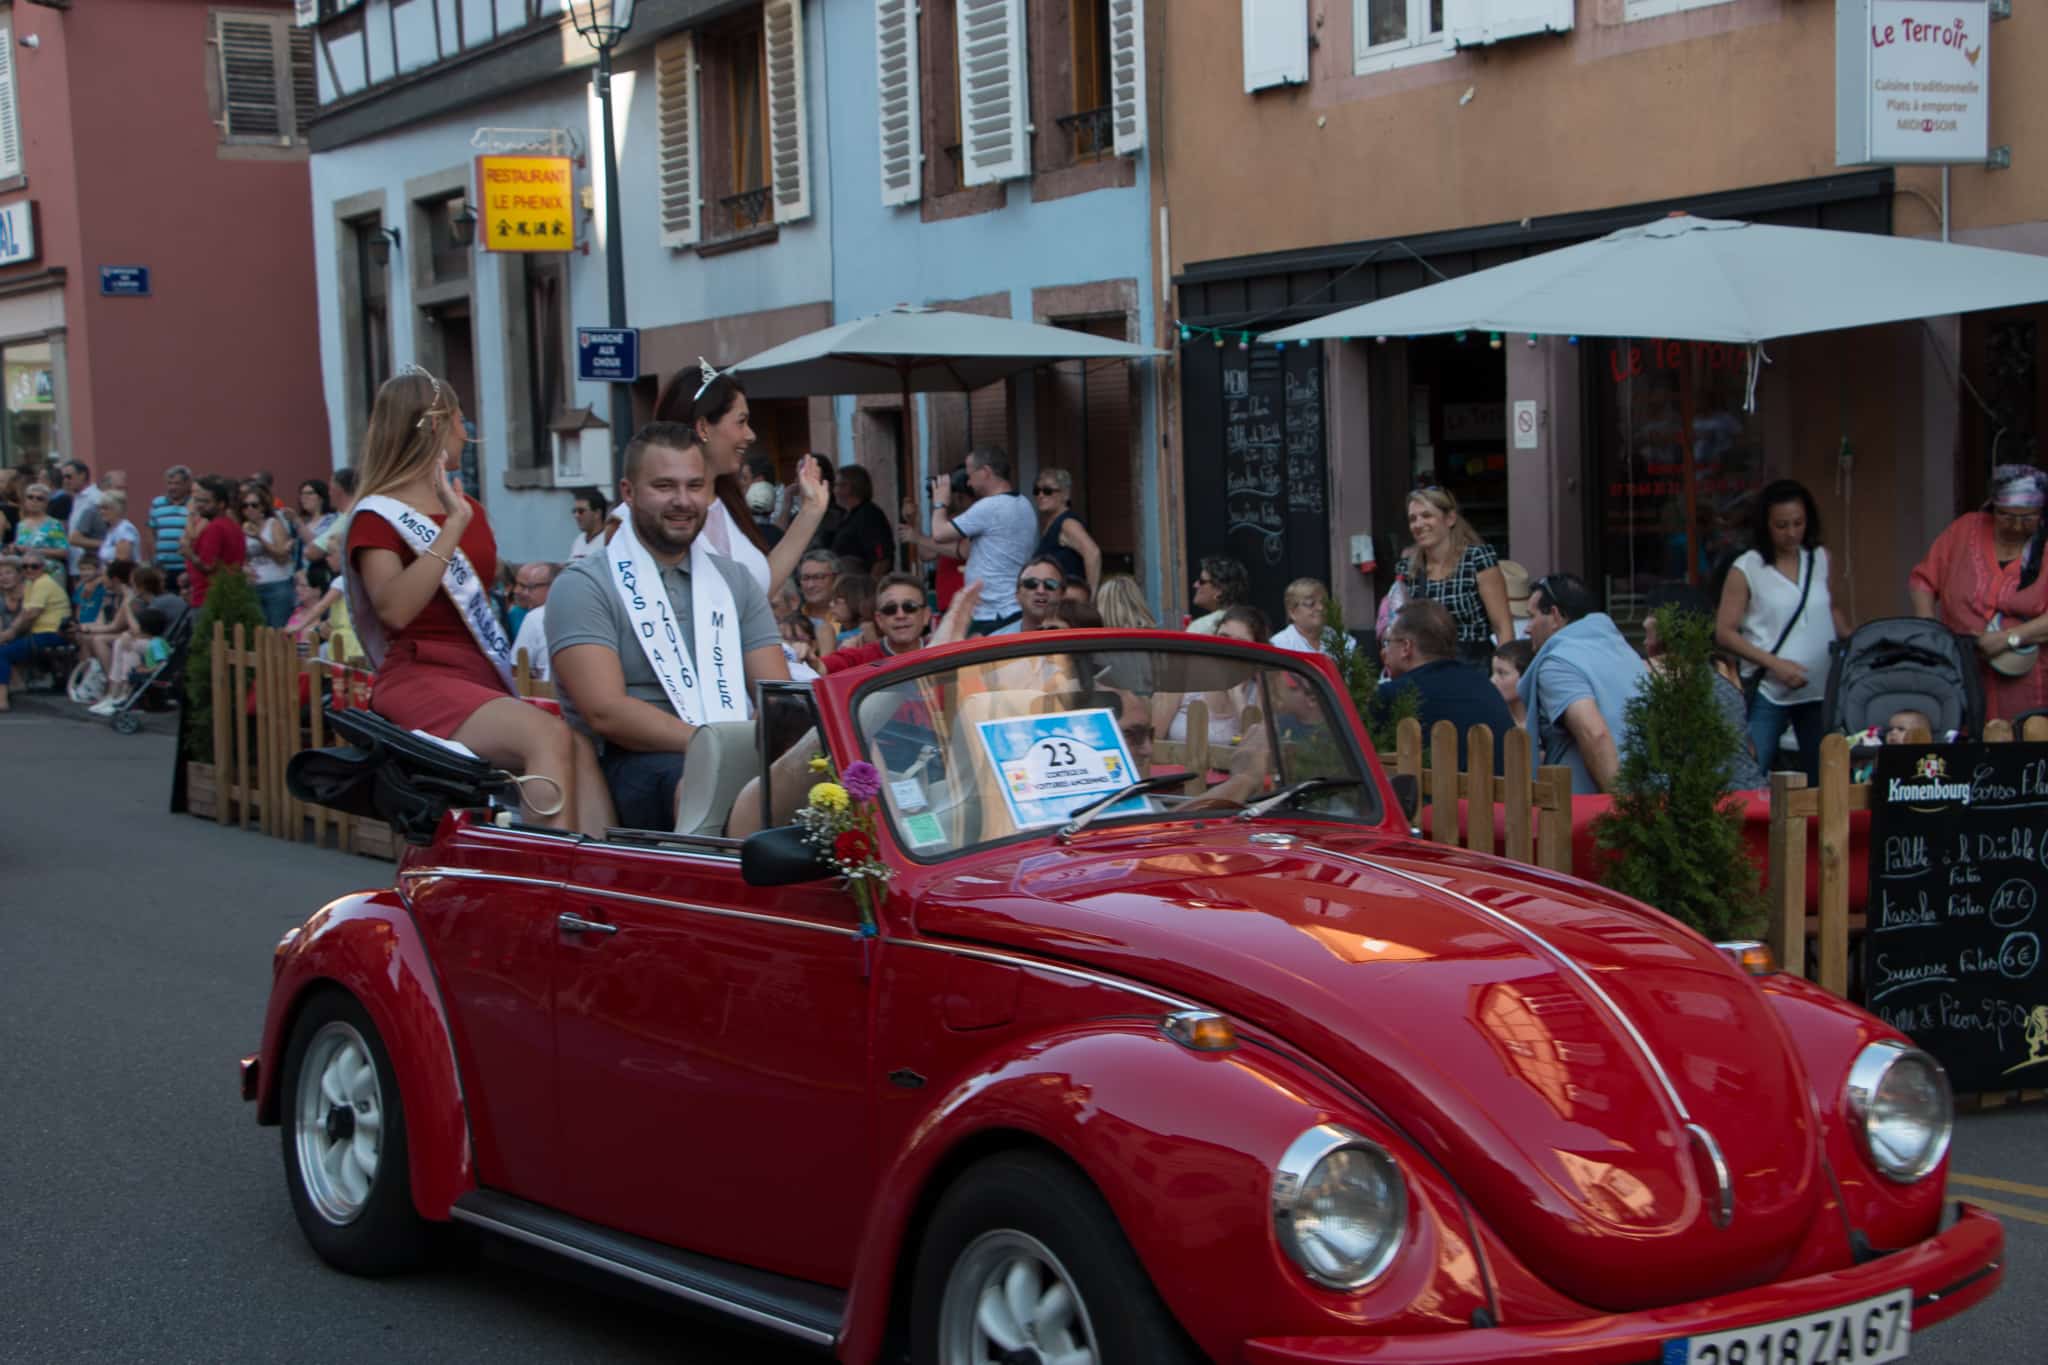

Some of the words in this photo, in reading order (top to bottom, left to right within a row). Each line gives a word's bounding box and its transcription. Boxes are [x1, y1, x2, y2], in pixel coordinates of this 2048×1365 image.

[1871, 25, 1895, 48] Le
[1901, 17, 1969, 49] Terroir
[1875, 79, 1910, 92] Cuisine
[1912, 80, 1979, 95] traditionnelle
[1887, 98, 1910, 112] Plats
[1921, 101, 1968, 114] emporter
[487, 167, 565, 184] RESTAURANT
[494, 195, 511, 210] LE
[1610, 346, 1643, 383] Le
[398, 511, 436, 544] MISS
[450, 555, 468, 586] AYS
[617, 560, 647, 611] PAYS
[656, 600, 694, 689] 2016
[711, 610, 735, 710] MISTER
[1041, 742, 1078, 767] 23
[1887, 777, 1971, 806] Kronenbourg
